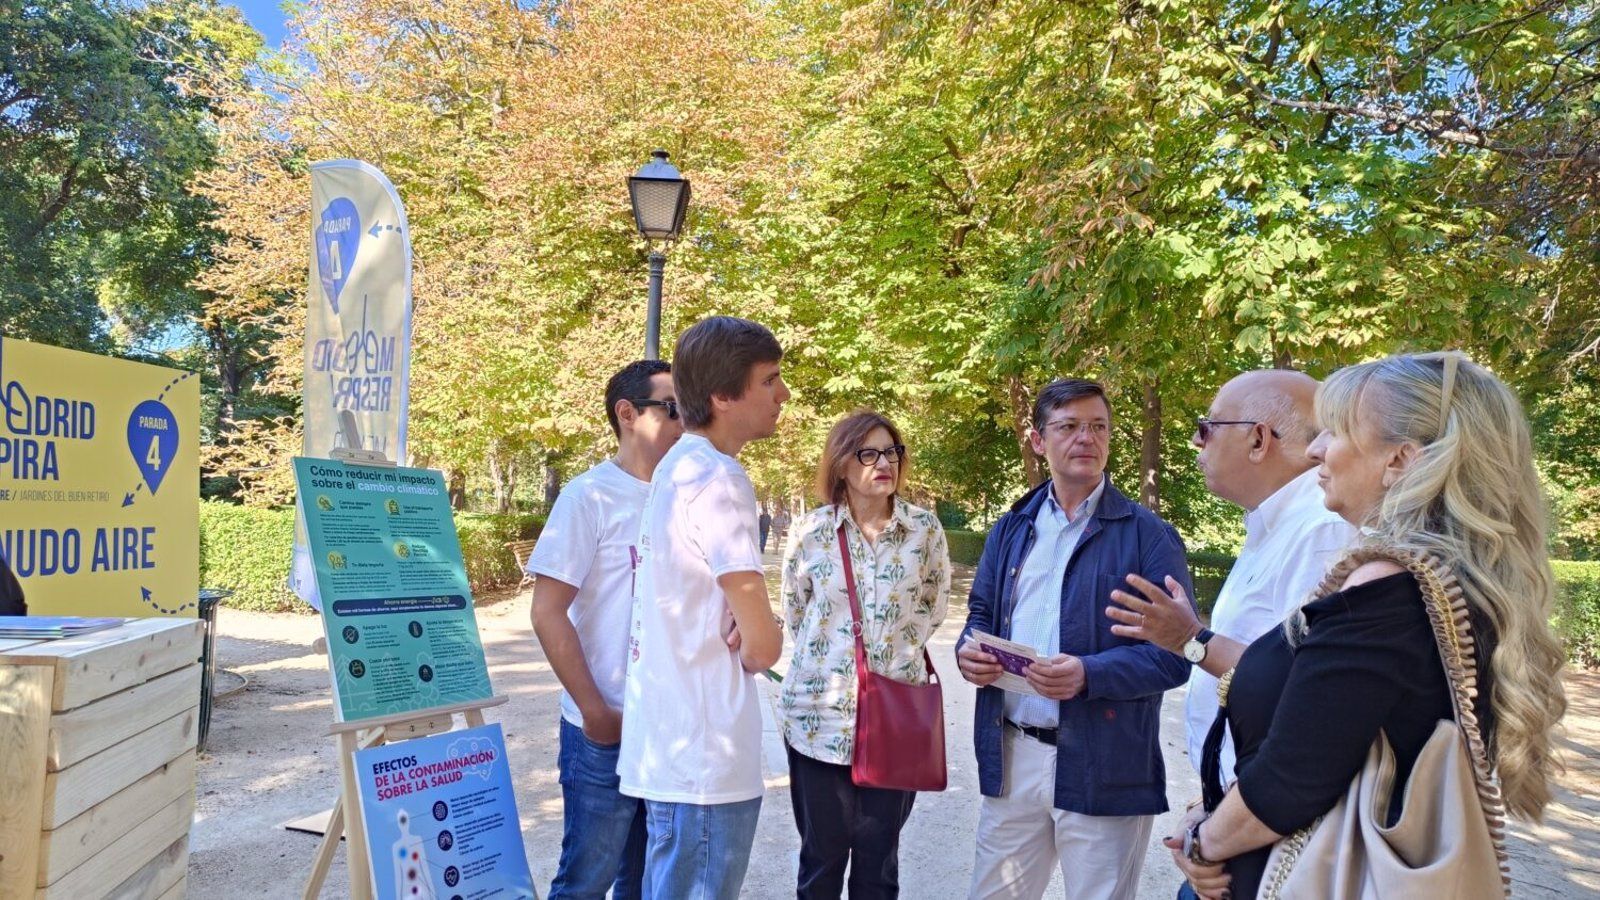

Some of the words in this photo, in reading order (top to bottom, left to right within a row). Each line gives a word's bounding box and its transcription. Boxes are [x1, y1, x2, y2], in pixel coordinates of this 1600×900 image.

[139, 416, 168, 430] PARADA
[146, 435, 161, 470] 4
[310, 465, 342, 478] Cómo
[346, 470, 381, 482] reducir
[385, 472, 396, 482] mi
[400, 474, 436, 486] impacto
[20, 491, 52, 501] JARDINES
[54, 491, 66, 501] DEL
[68, 492, 86, 501] BUEN
[87, 492, 109, 502] RETIRO
[312, 478, 343, 489] sobre
[346, 480, 355, 490] el
[358, 481, 395, 492] cambio
[397, 484, 439, 496] climático
[91, 527, 156, 572] AIRE
[372, 756, 417, 774] EFECTOS
[375, 776, 389, 788] DE
[392, 772, 406, 784] LA
[409, 751, 494, 780] CONTAMINACIÓN
[377, 784, 412, 801] SOBRE
[416, 780, 429, 791] LA
[432, 771, 463, 788] SALUD
